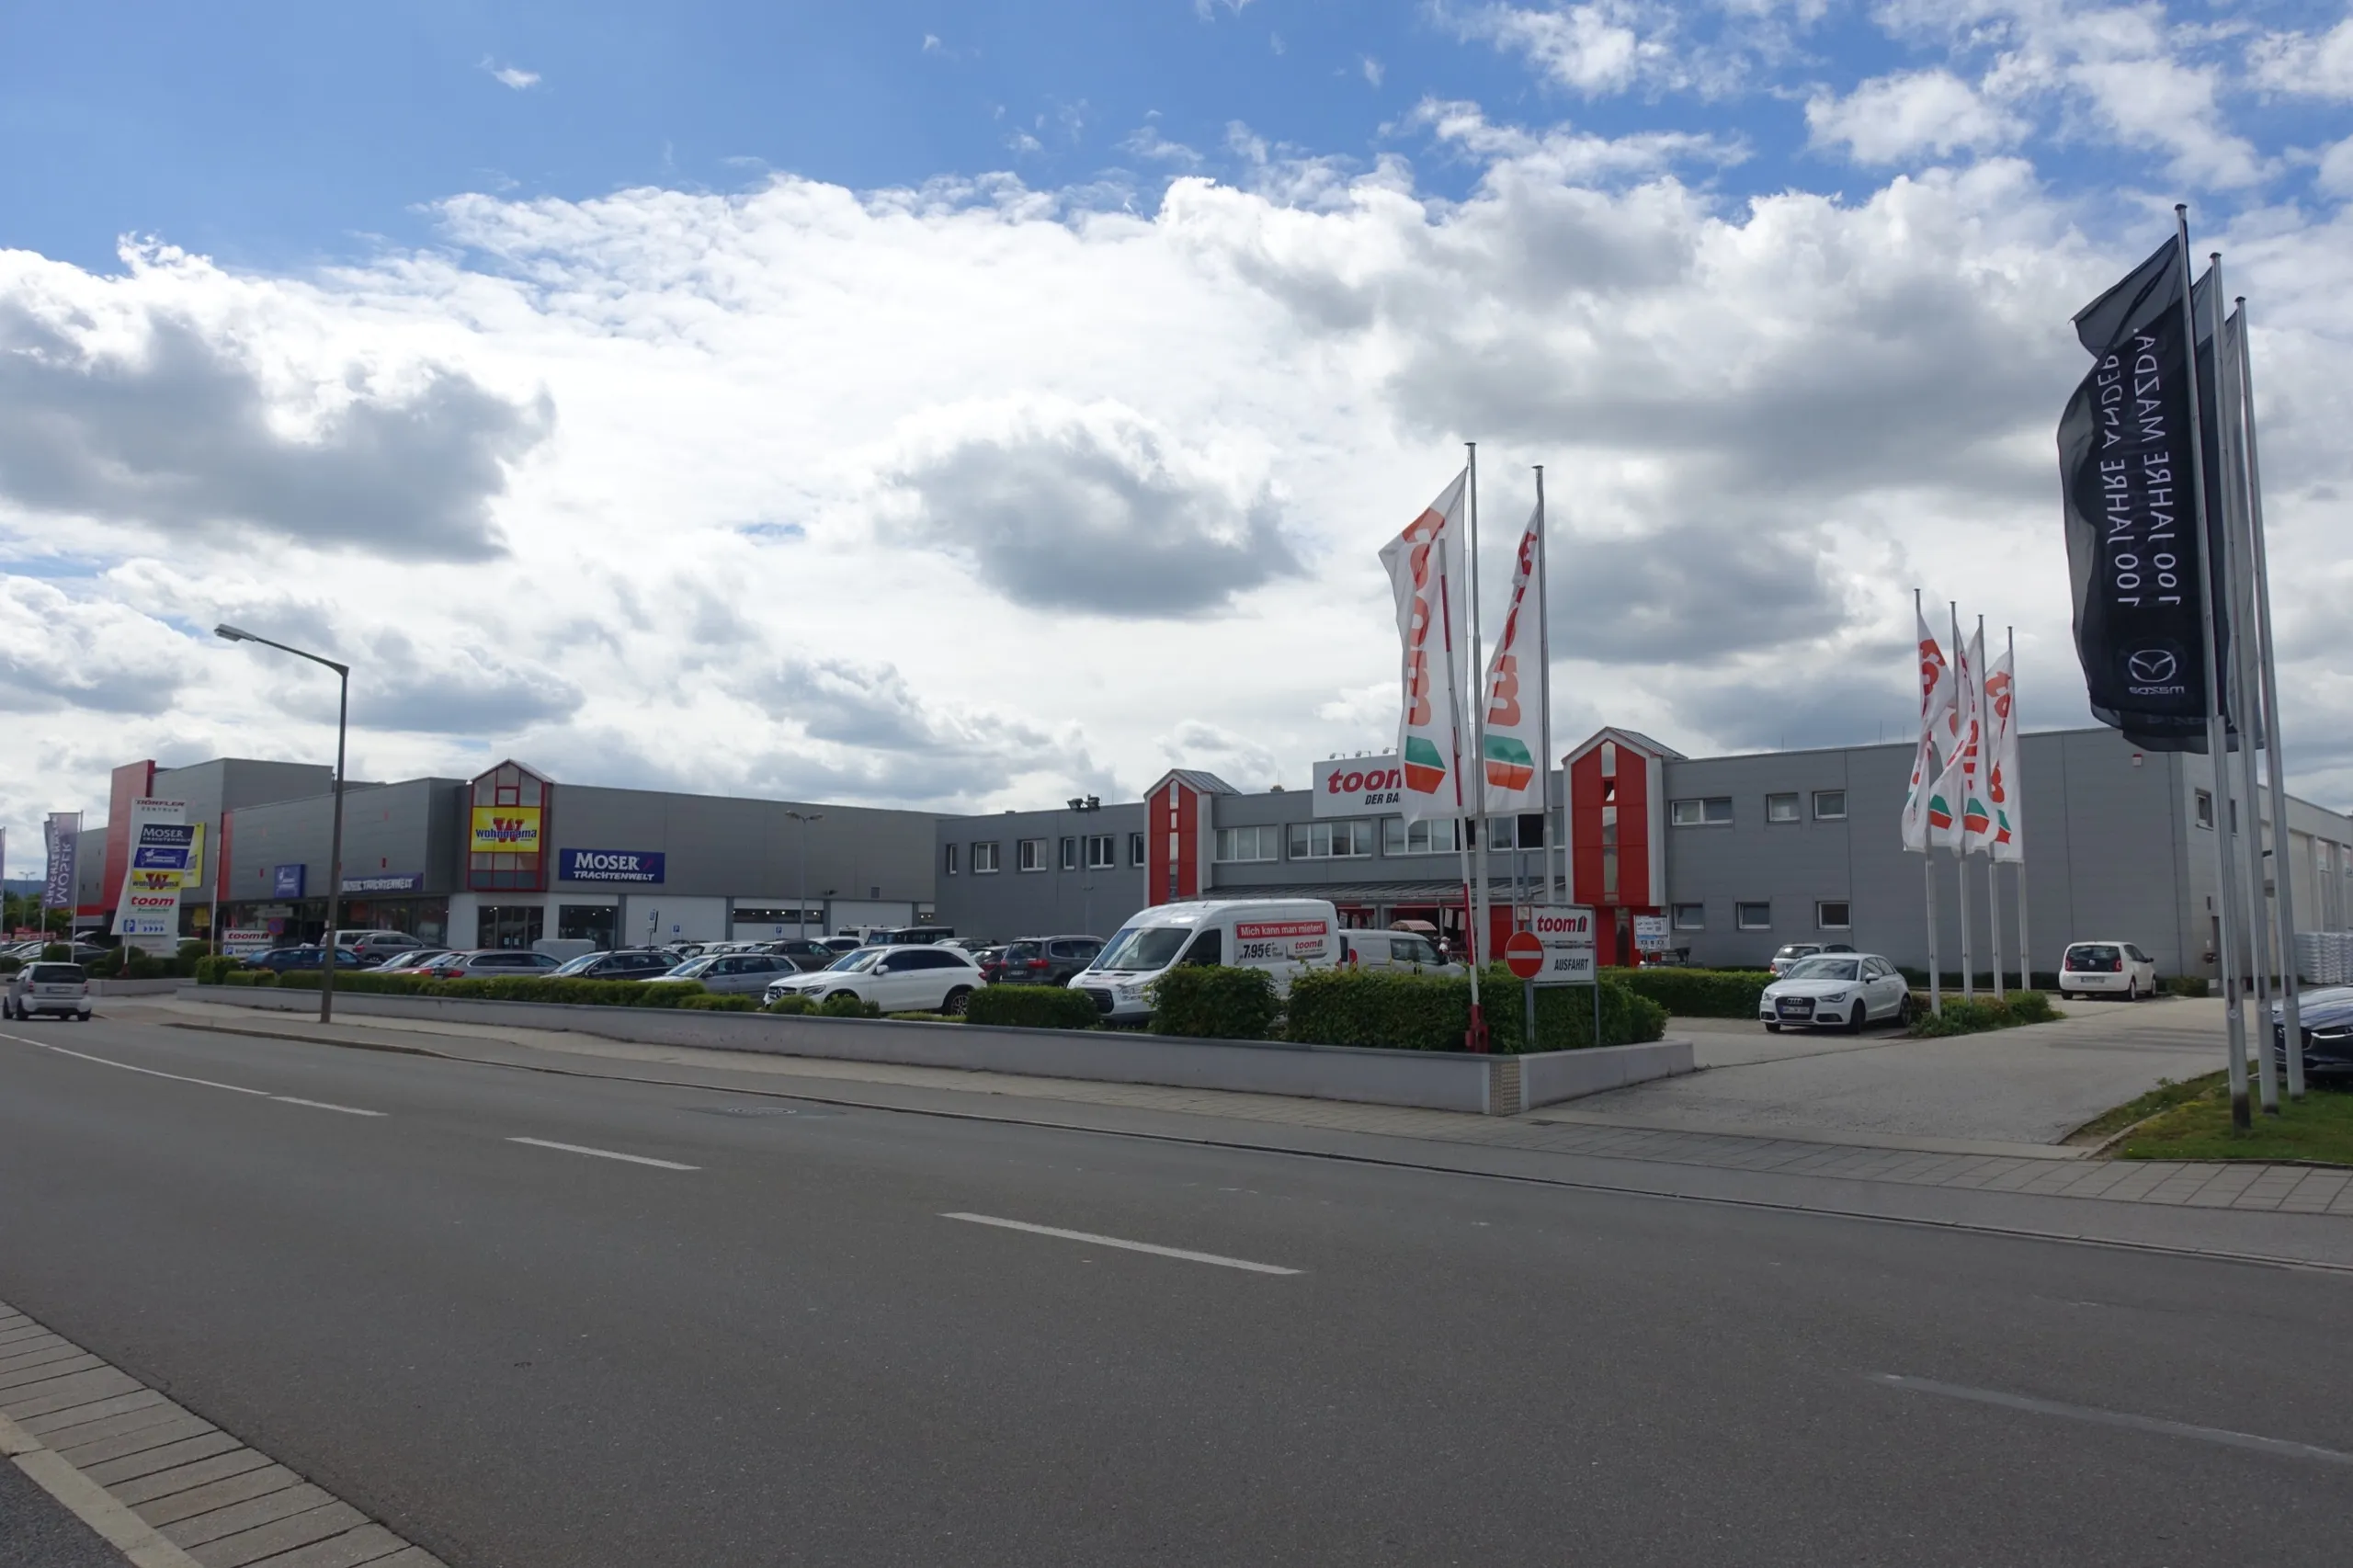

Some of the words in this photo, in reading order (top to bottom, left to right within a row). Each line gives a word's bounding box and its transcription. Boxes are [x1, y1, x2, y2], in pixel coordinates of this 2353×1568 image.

[1364, 793, 1384, 806] DER
[142, 828, 184, 838] MOSER
[475, 828, 538, 839] wohnorama
[574, 852, 641, 870] MOSER
[573, 870, 655, 881] TRACHTENWELT
[131, 896, 175, 906] toom
[1537, 915, 1576, 933] toom
[1241, 926, 1260, 937] Mich
[1261, 926, 1280, 936] kann
[1281, 926, 1298, 934] man
[1298, 923, 1324, 933] mieten!
[228, 932, 260, 940] toom
[1295, 940, 1317, 950] toom
[1553, 959, 1589, 971] AUSFAHRT
